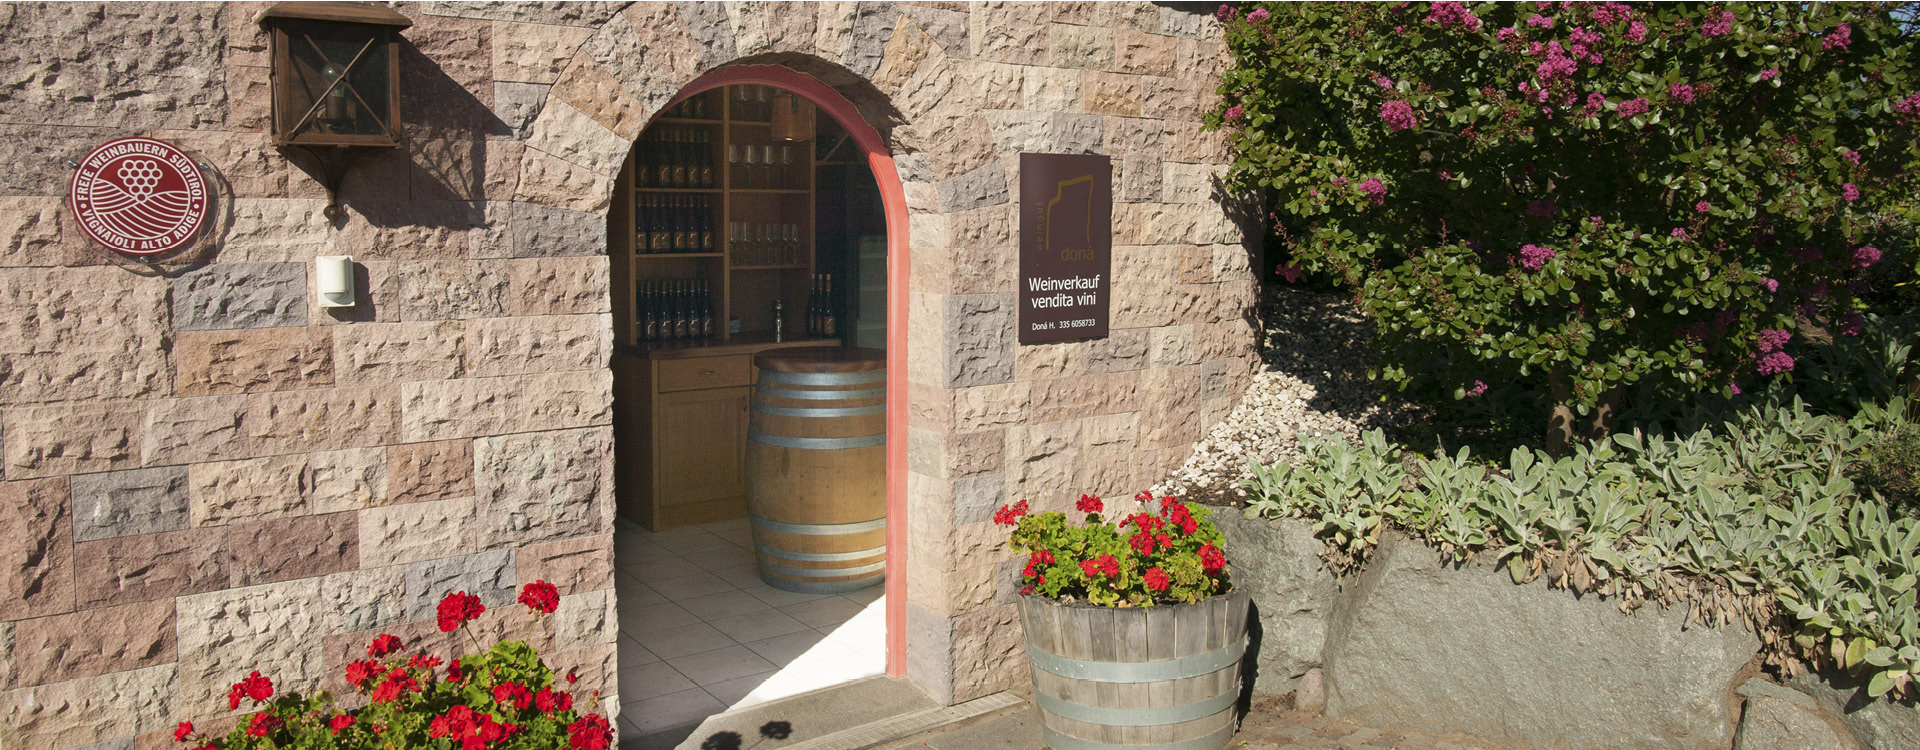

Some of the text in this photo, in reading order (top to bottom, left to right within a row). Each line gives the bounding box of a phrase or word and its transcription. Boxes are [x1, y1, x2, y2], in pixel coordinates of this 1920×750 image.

[77, 142, 202, 203] FREIE WEINBAUERN SÜDTIROL
[82, 209, 200, 249] VIGNAIOLI ALTO ADIGE
[1036, 202, 1044, 251] weingut
[1028, 274, 1100, 291] Weinverkauf
[1031, 291, 1096, 308] vendita vini
[1049, 322, 1056, 330] H.
[1059, 320, 1070, 329] 335
[1071, 318, 1096, 328] 6058733
